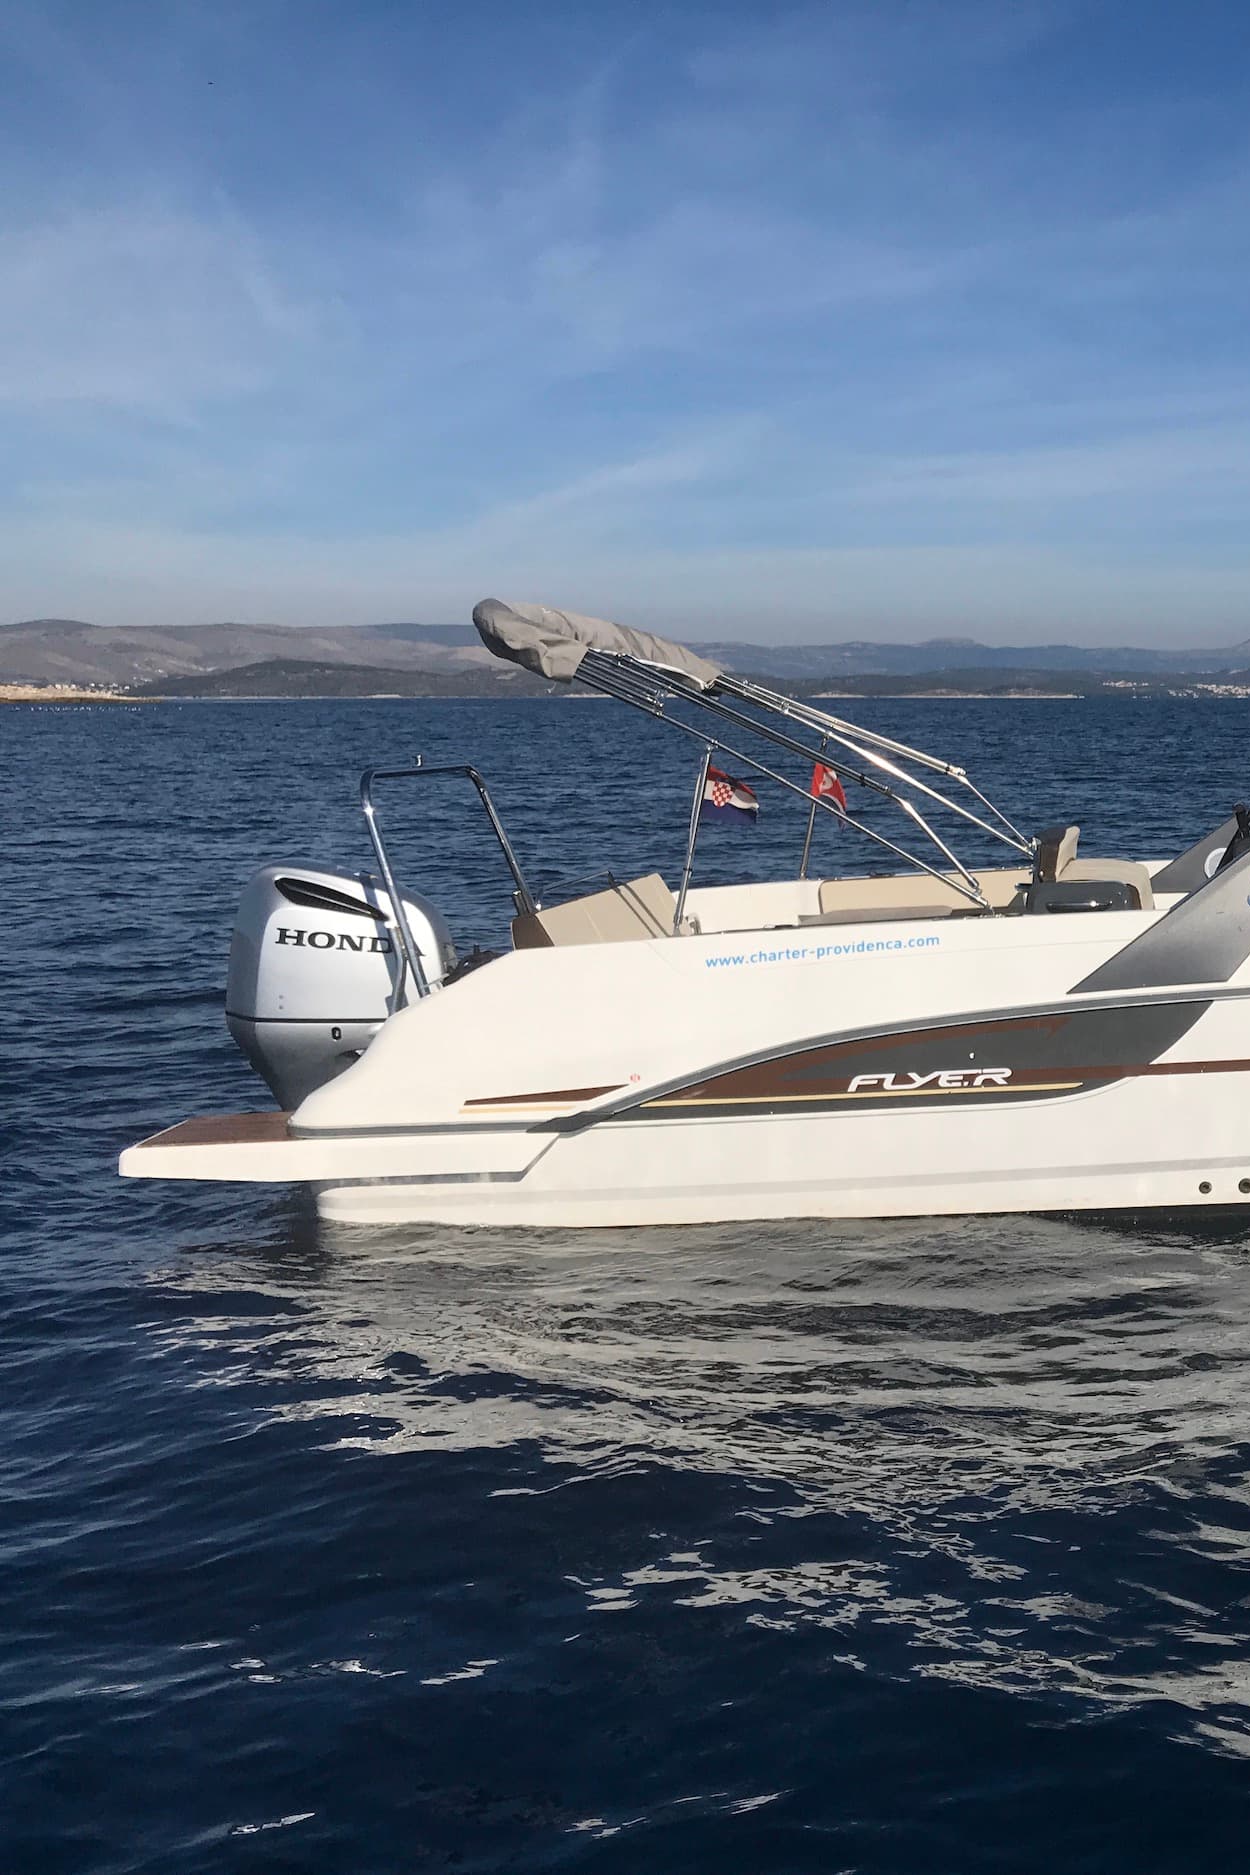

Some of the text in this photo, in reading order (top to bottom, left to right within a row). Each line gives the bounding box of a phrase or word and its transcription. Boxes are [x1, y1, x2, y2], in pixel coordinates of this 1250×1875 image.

[275, 927, 426, 957] HOND
[705, 935, 940, 968] www.charter-providenca.com
[847, 1067, 1012, 1093] FLYER
